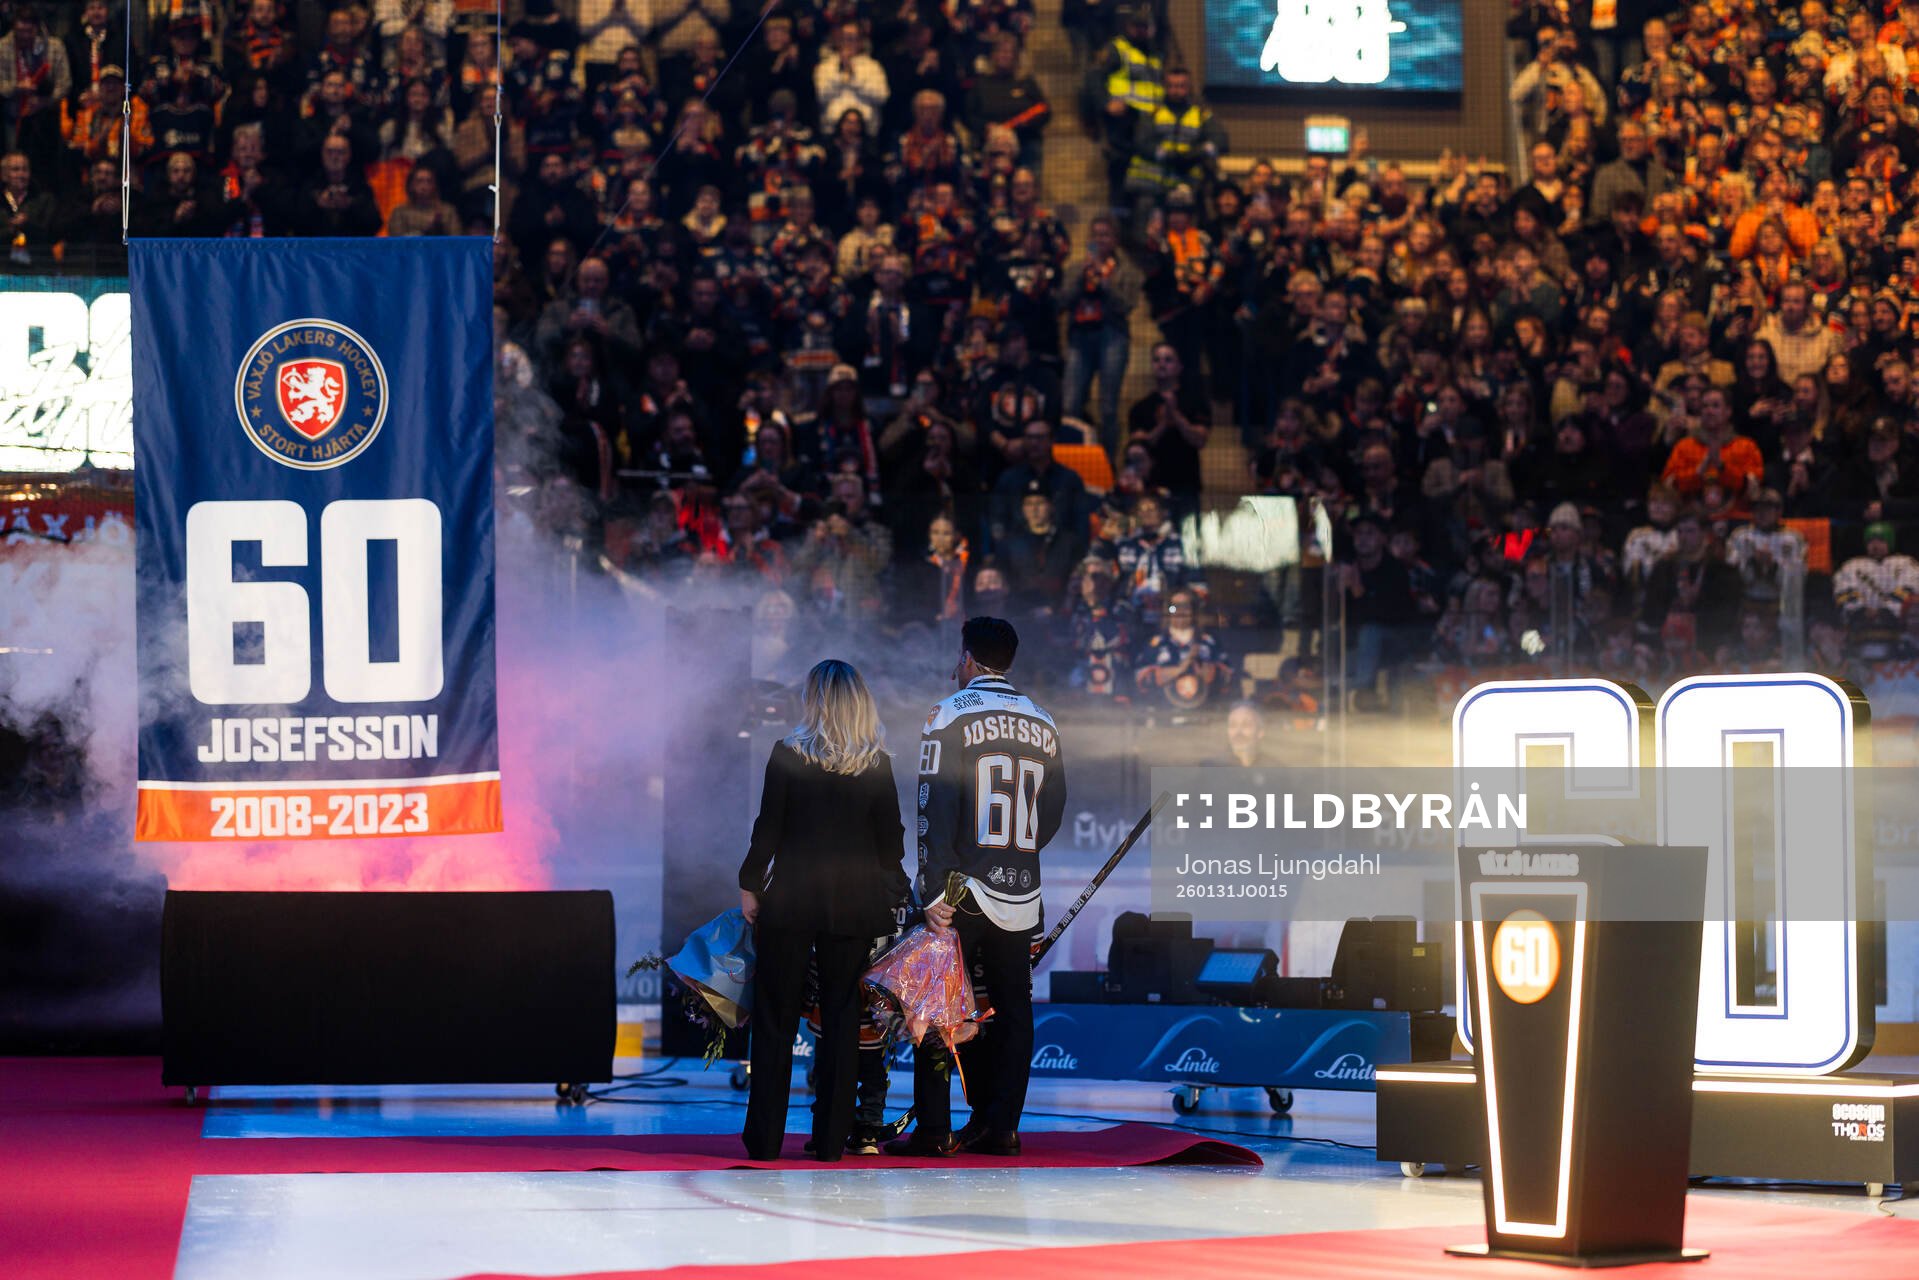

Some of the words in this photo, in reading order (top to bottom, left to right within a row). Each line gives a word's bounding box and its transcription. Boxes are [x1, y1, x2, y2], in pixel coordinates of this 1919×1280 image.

[246, 350, 274, 400] VÄXJÖ
[273, 330, 336, 353] LAKERS
[338, 340, 377, 400] HOCKEY
[259, 424, 307, 458] STORT
[312, 423, 368, 459] HJÄRTA
[0, 507, 129, 546] ÄXJÖ
[186, 498, 444, 704] 60
[953, 697, 984, 710] SEATING
[198, 714, 438, 762] JOSEFSSON
[210, 793, 429, 837] 2008-2023
[975, 752, 1045, 853] 60
[1500, 926, 1549, 986] 60
[1031, 1044, 1078, 1070] Linde
[1165, 1047, 1220, 1073] Linde
[1832, 1122, 1886, 1137] THOROS
